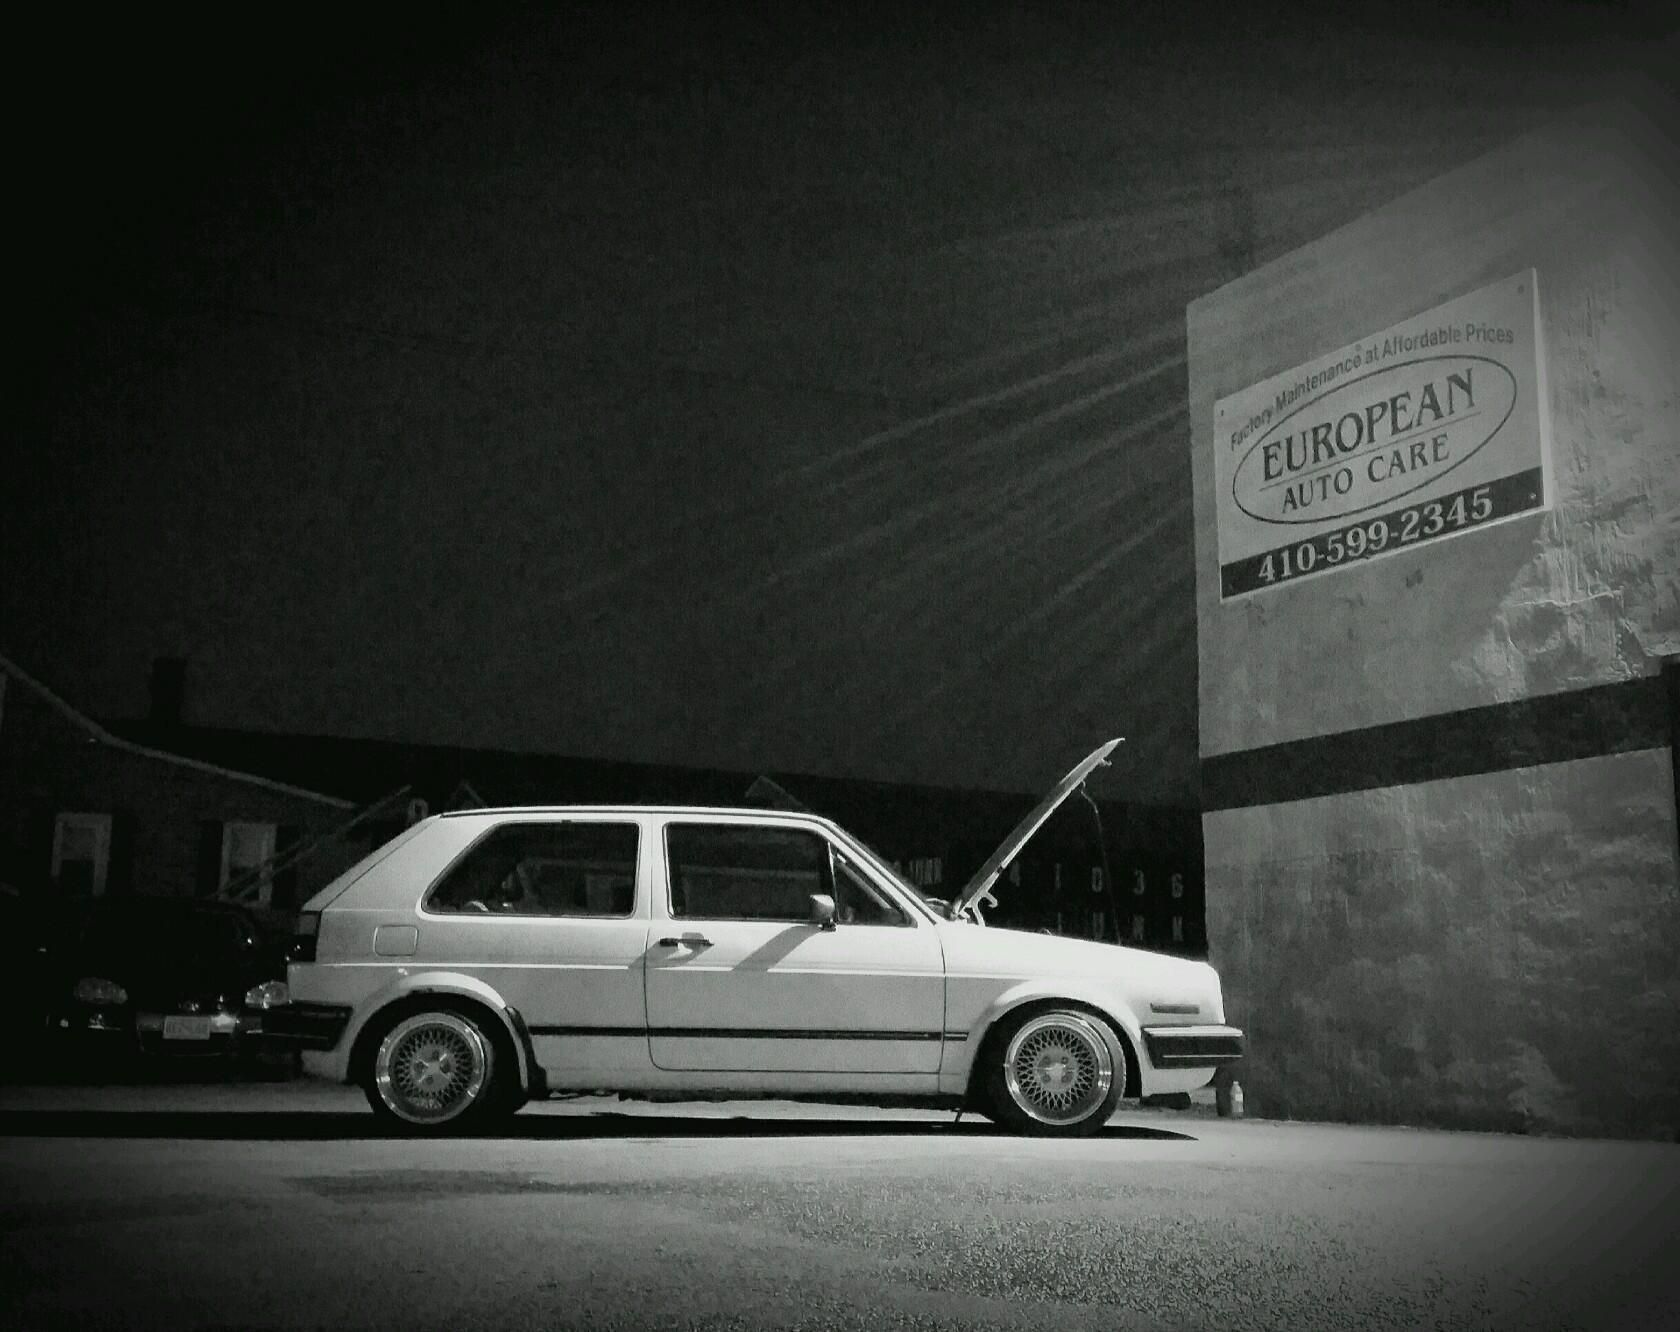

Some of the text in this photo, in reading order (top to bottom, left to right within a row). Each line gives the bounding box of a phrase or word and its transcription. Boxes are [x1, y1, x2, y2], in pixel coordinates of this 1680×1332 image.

[1231, 323, 1514, 450] Factory Maintenance at Affordable Prices
[1262, 367, 1475, 481] EUROPEAN
[1282, 433, 1450, 514] AUTO CARE
[1258, 487, 1493, 583] 410-599-2345
